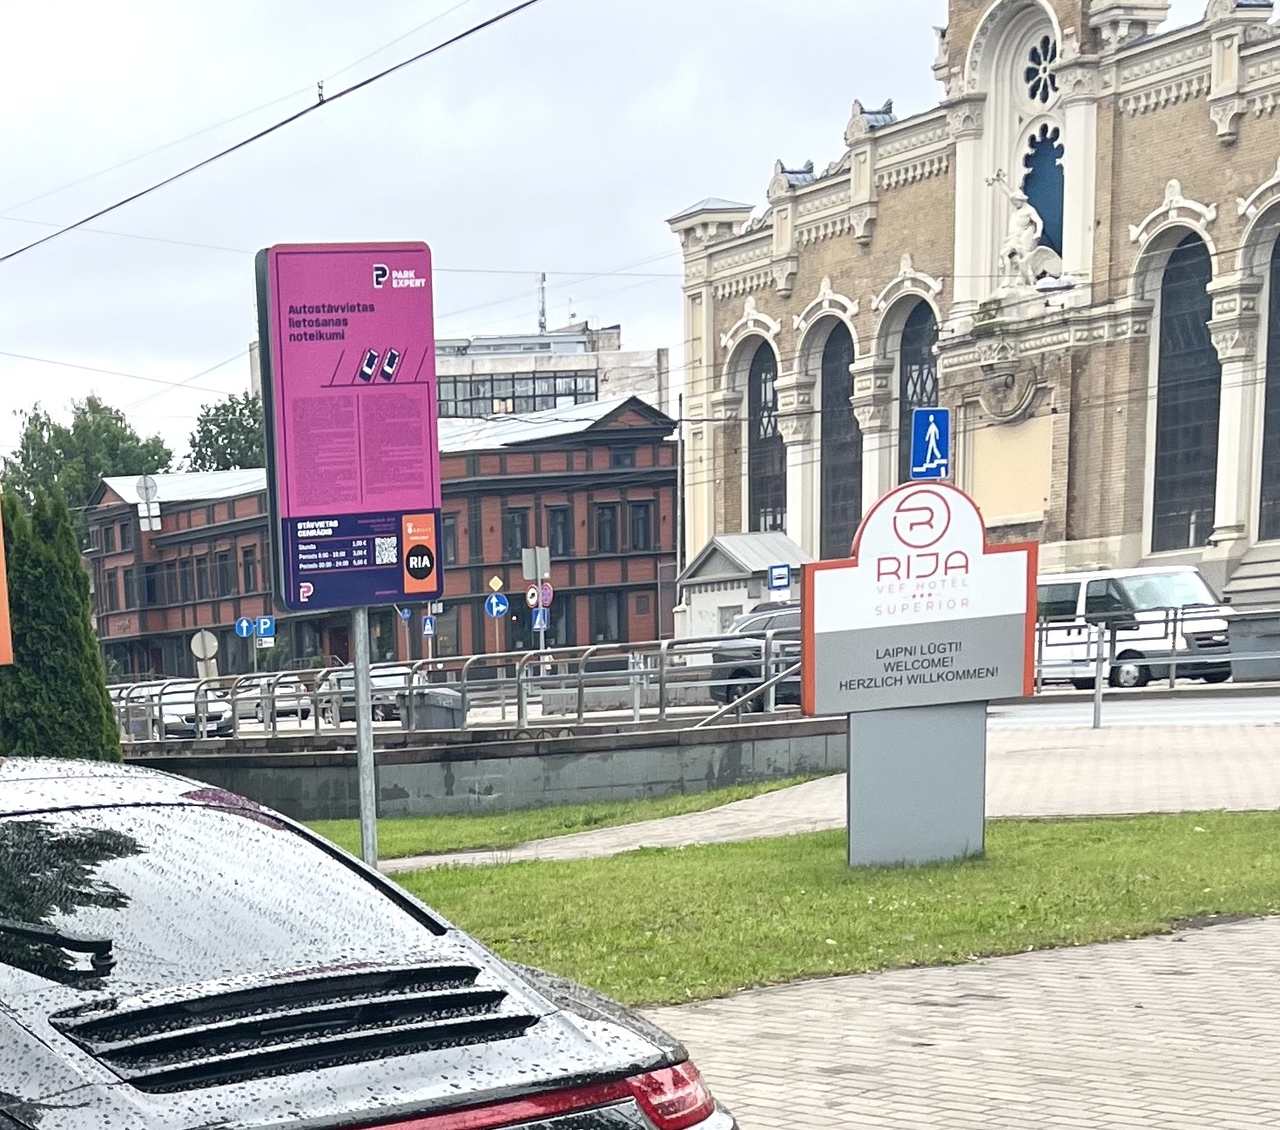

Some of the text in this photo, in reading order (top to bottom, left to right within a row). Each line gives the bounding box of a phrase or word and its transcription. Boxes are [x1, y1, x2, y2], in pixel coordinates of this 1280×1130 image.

[392, 270, 415, 279] PARK
[392, 279, 426, 288] EXPERT
[289, 330, 345, 342] noteikumi
[409, 556, 431, 569] RIA
[877, 550, 969, 582] RIJA
[877, 578, 968, 595] VEF HOTEL
[875, 598, 969, 616] SUPERIOR
[260, 618, 270, 634] P
[876, 646, 916, 660] LAIPNI
[883, 656, 954, 672] WELCOME!
[839, 667, 999, 691] HERZLICH WILLKOMMEN!
